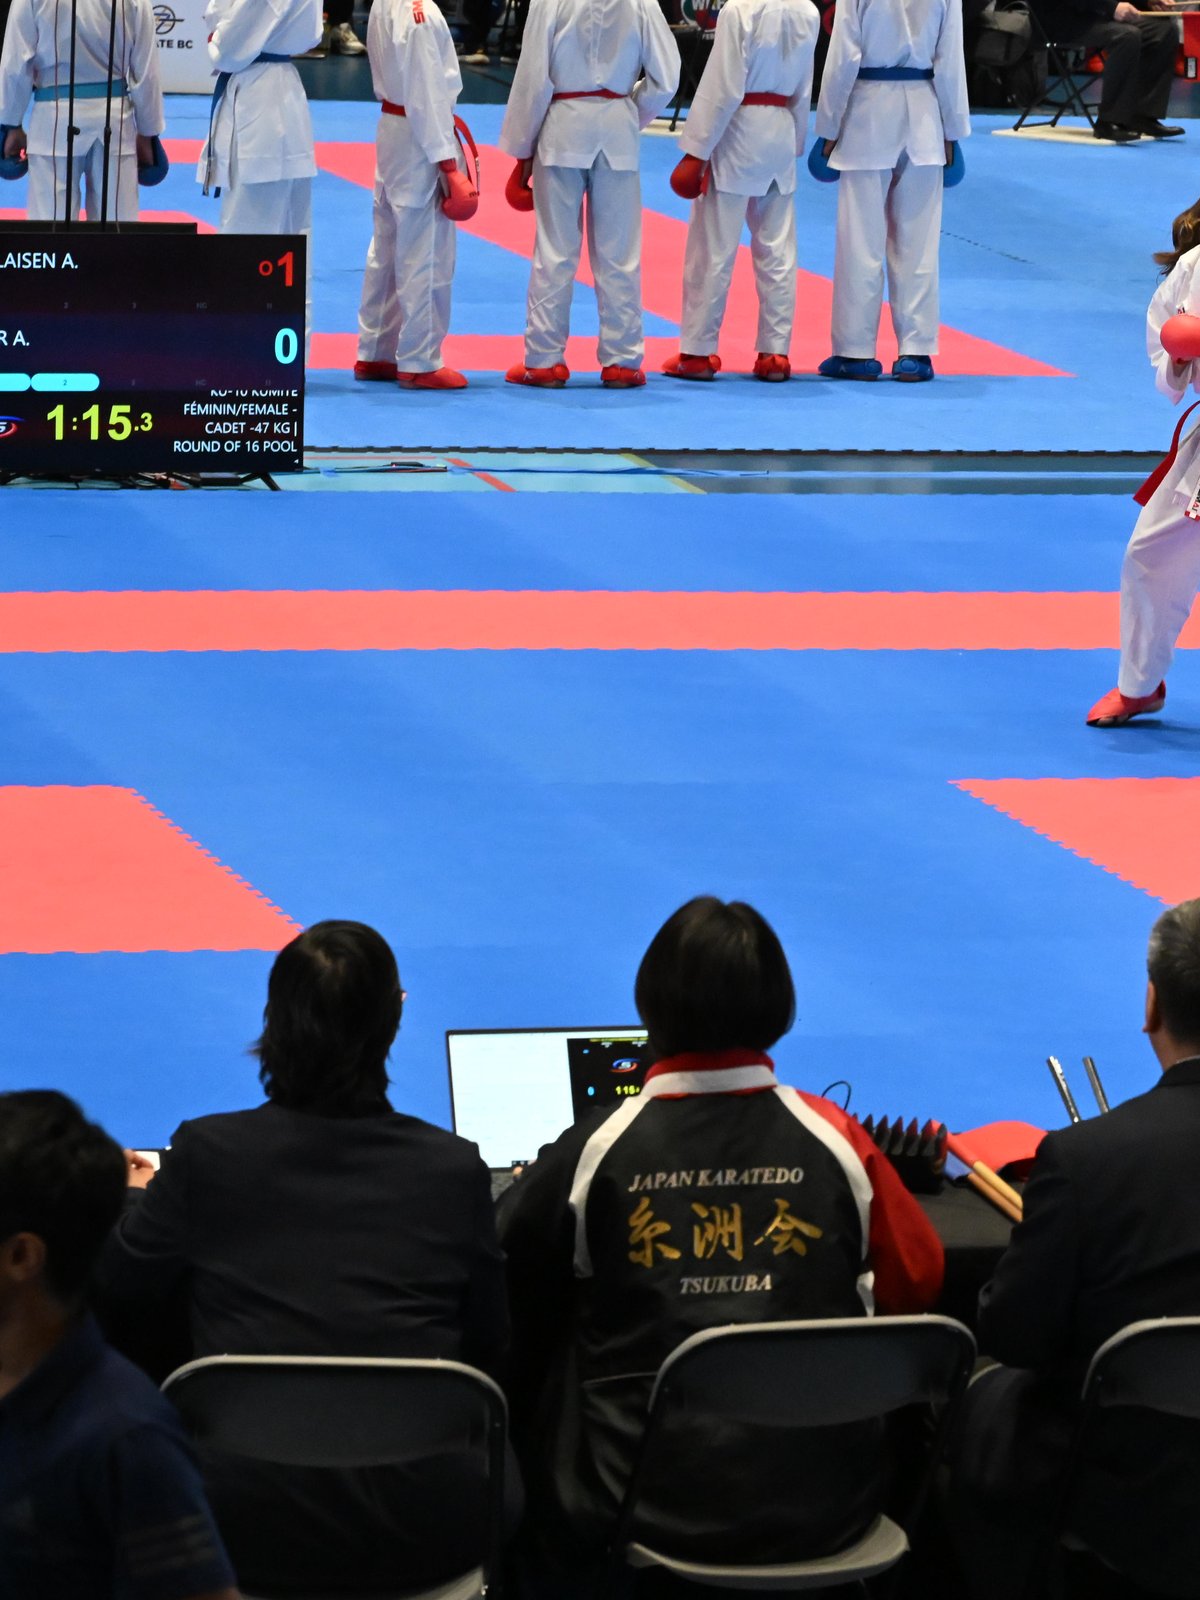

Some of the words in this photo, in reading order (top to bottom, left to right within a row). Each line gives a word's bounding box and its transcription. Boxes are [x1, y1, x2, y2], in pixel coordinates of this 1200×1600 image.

[177, 40, 193, 49] BC
[61, 252, 78, 269] A.
[13, 330, 30, 346] A.
[274, 327, 298, 364] 0
[183, 400, 289, 416] FÉMININ/FEMALE
[46, 404, 153, 441] 1:15.3
[204, 422, 246, 434] CADET
[249, 422, 270, 434] -47
[273, 422, 291, 434] KG
[173, 440, 221, 453] ROUND
[223, 440, 241, 453] OF
[245, 440, 260, 453] 16
[263, 440, 297, 453] POOL
[628, 1170, 694, 1192] JAPAN
[697, 1167, 804, 1187] KARATEDO
[680, 1274, 773, 1294] TSUKUBA
